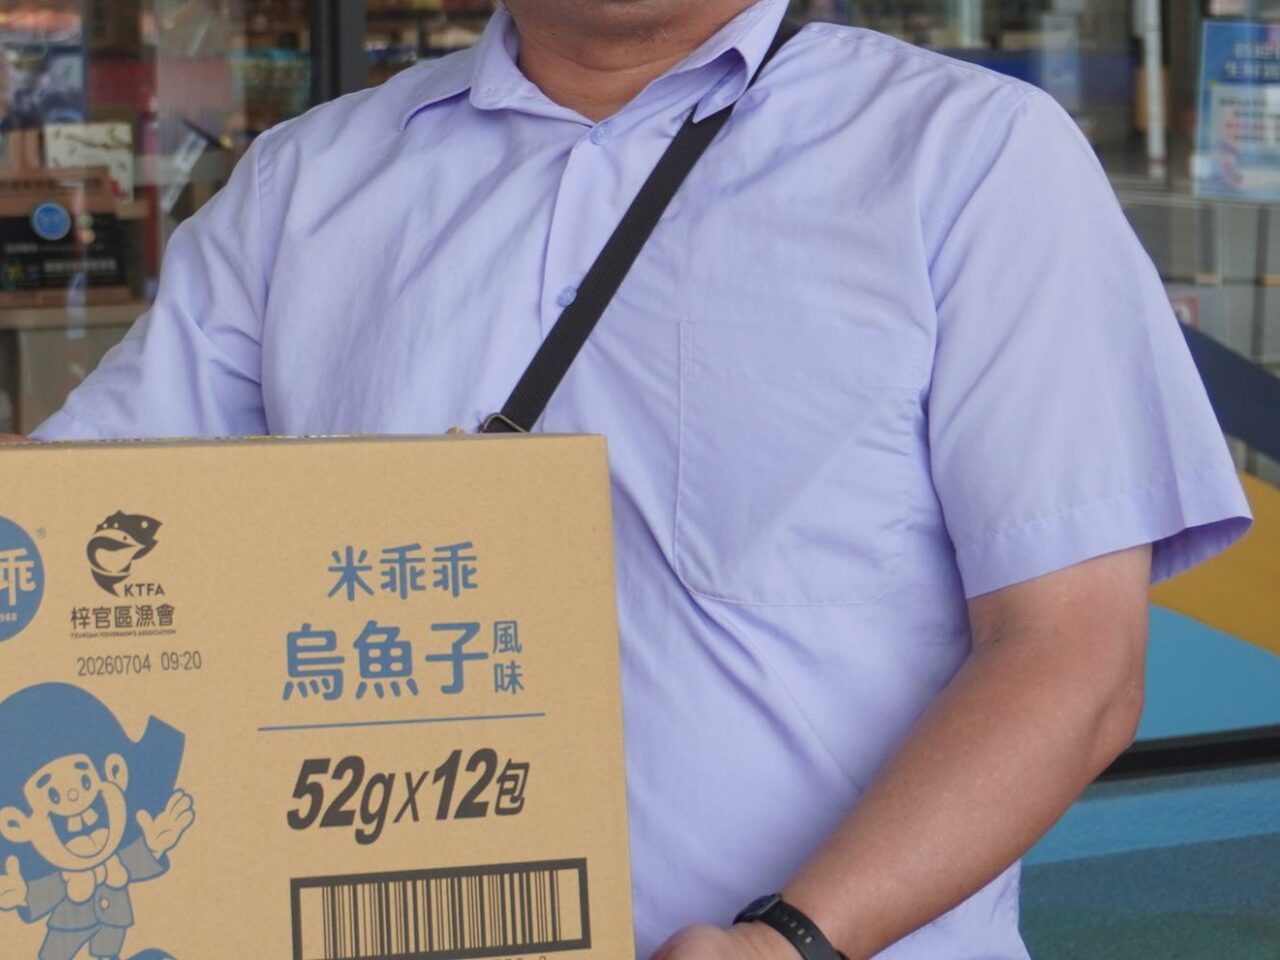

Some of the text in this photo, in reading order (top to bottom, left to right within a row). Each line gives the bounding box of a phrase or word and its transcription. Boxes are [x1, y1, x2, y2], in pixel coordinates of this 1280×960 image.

[124, 583, 166, 598] KTFA
[327, 541, 478, 602] 米乖乖
[71, 603, 175, 629] 梓官區漁會
[77, 650, 202, 676] 20260704 09:20
[282, 620, 489, 701] 烏魚子
[492, 620, 524, 695] 風味
